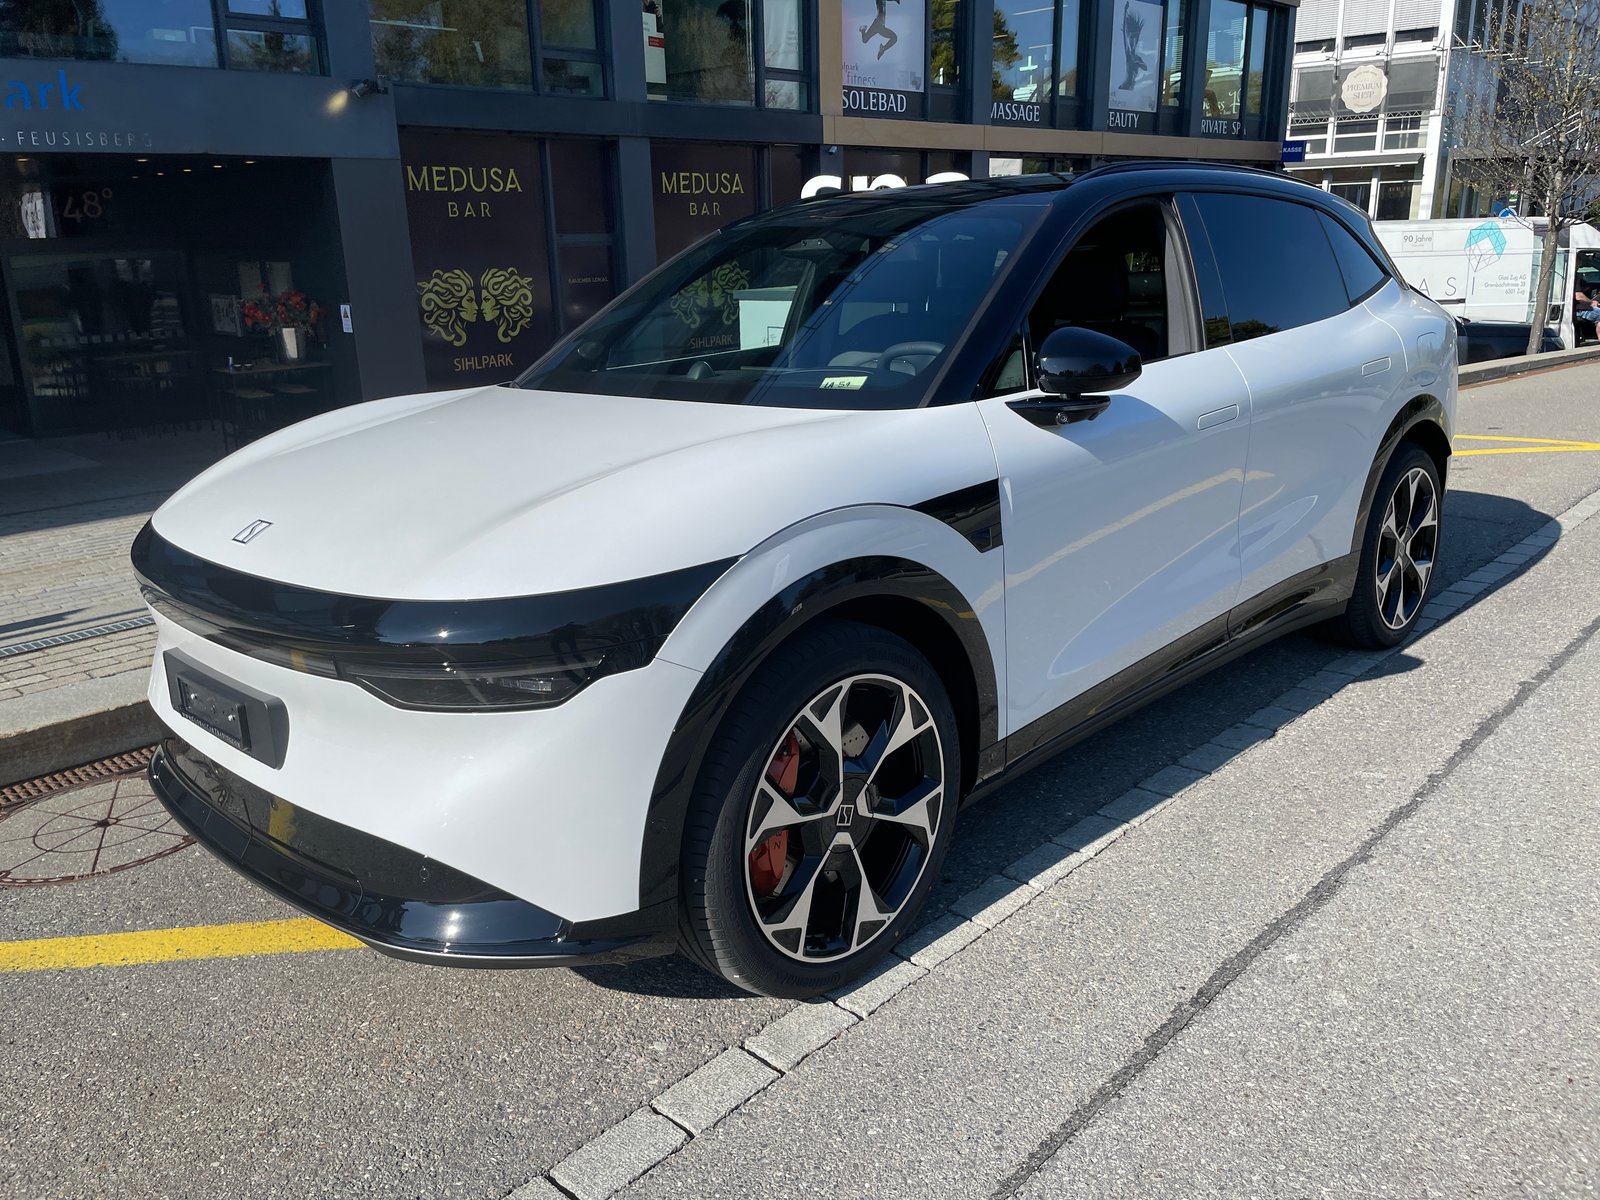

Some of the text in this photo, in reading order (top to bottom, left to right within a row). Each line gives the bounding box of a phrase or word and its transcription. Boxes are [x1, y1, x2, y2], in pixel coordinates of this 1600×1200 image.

[1347, 82, 1382, 91] PREMIUM
[842, 89, 907, 112] SOLEBAD
[1107, 111, 1140, 128] EAUTY
[406, 165, 523, 193] MEDUSA
[661, 171, 745, 195] MEDUSA
[447, 202, 492, 218] BAR
[689, 202, 721, 216] BAR
[1403, 234, 1433, 244] 90 Jahre
[690, 334, 734, 350] SIHLPARK
[453, 353, 513, 372] SIHLPARK
